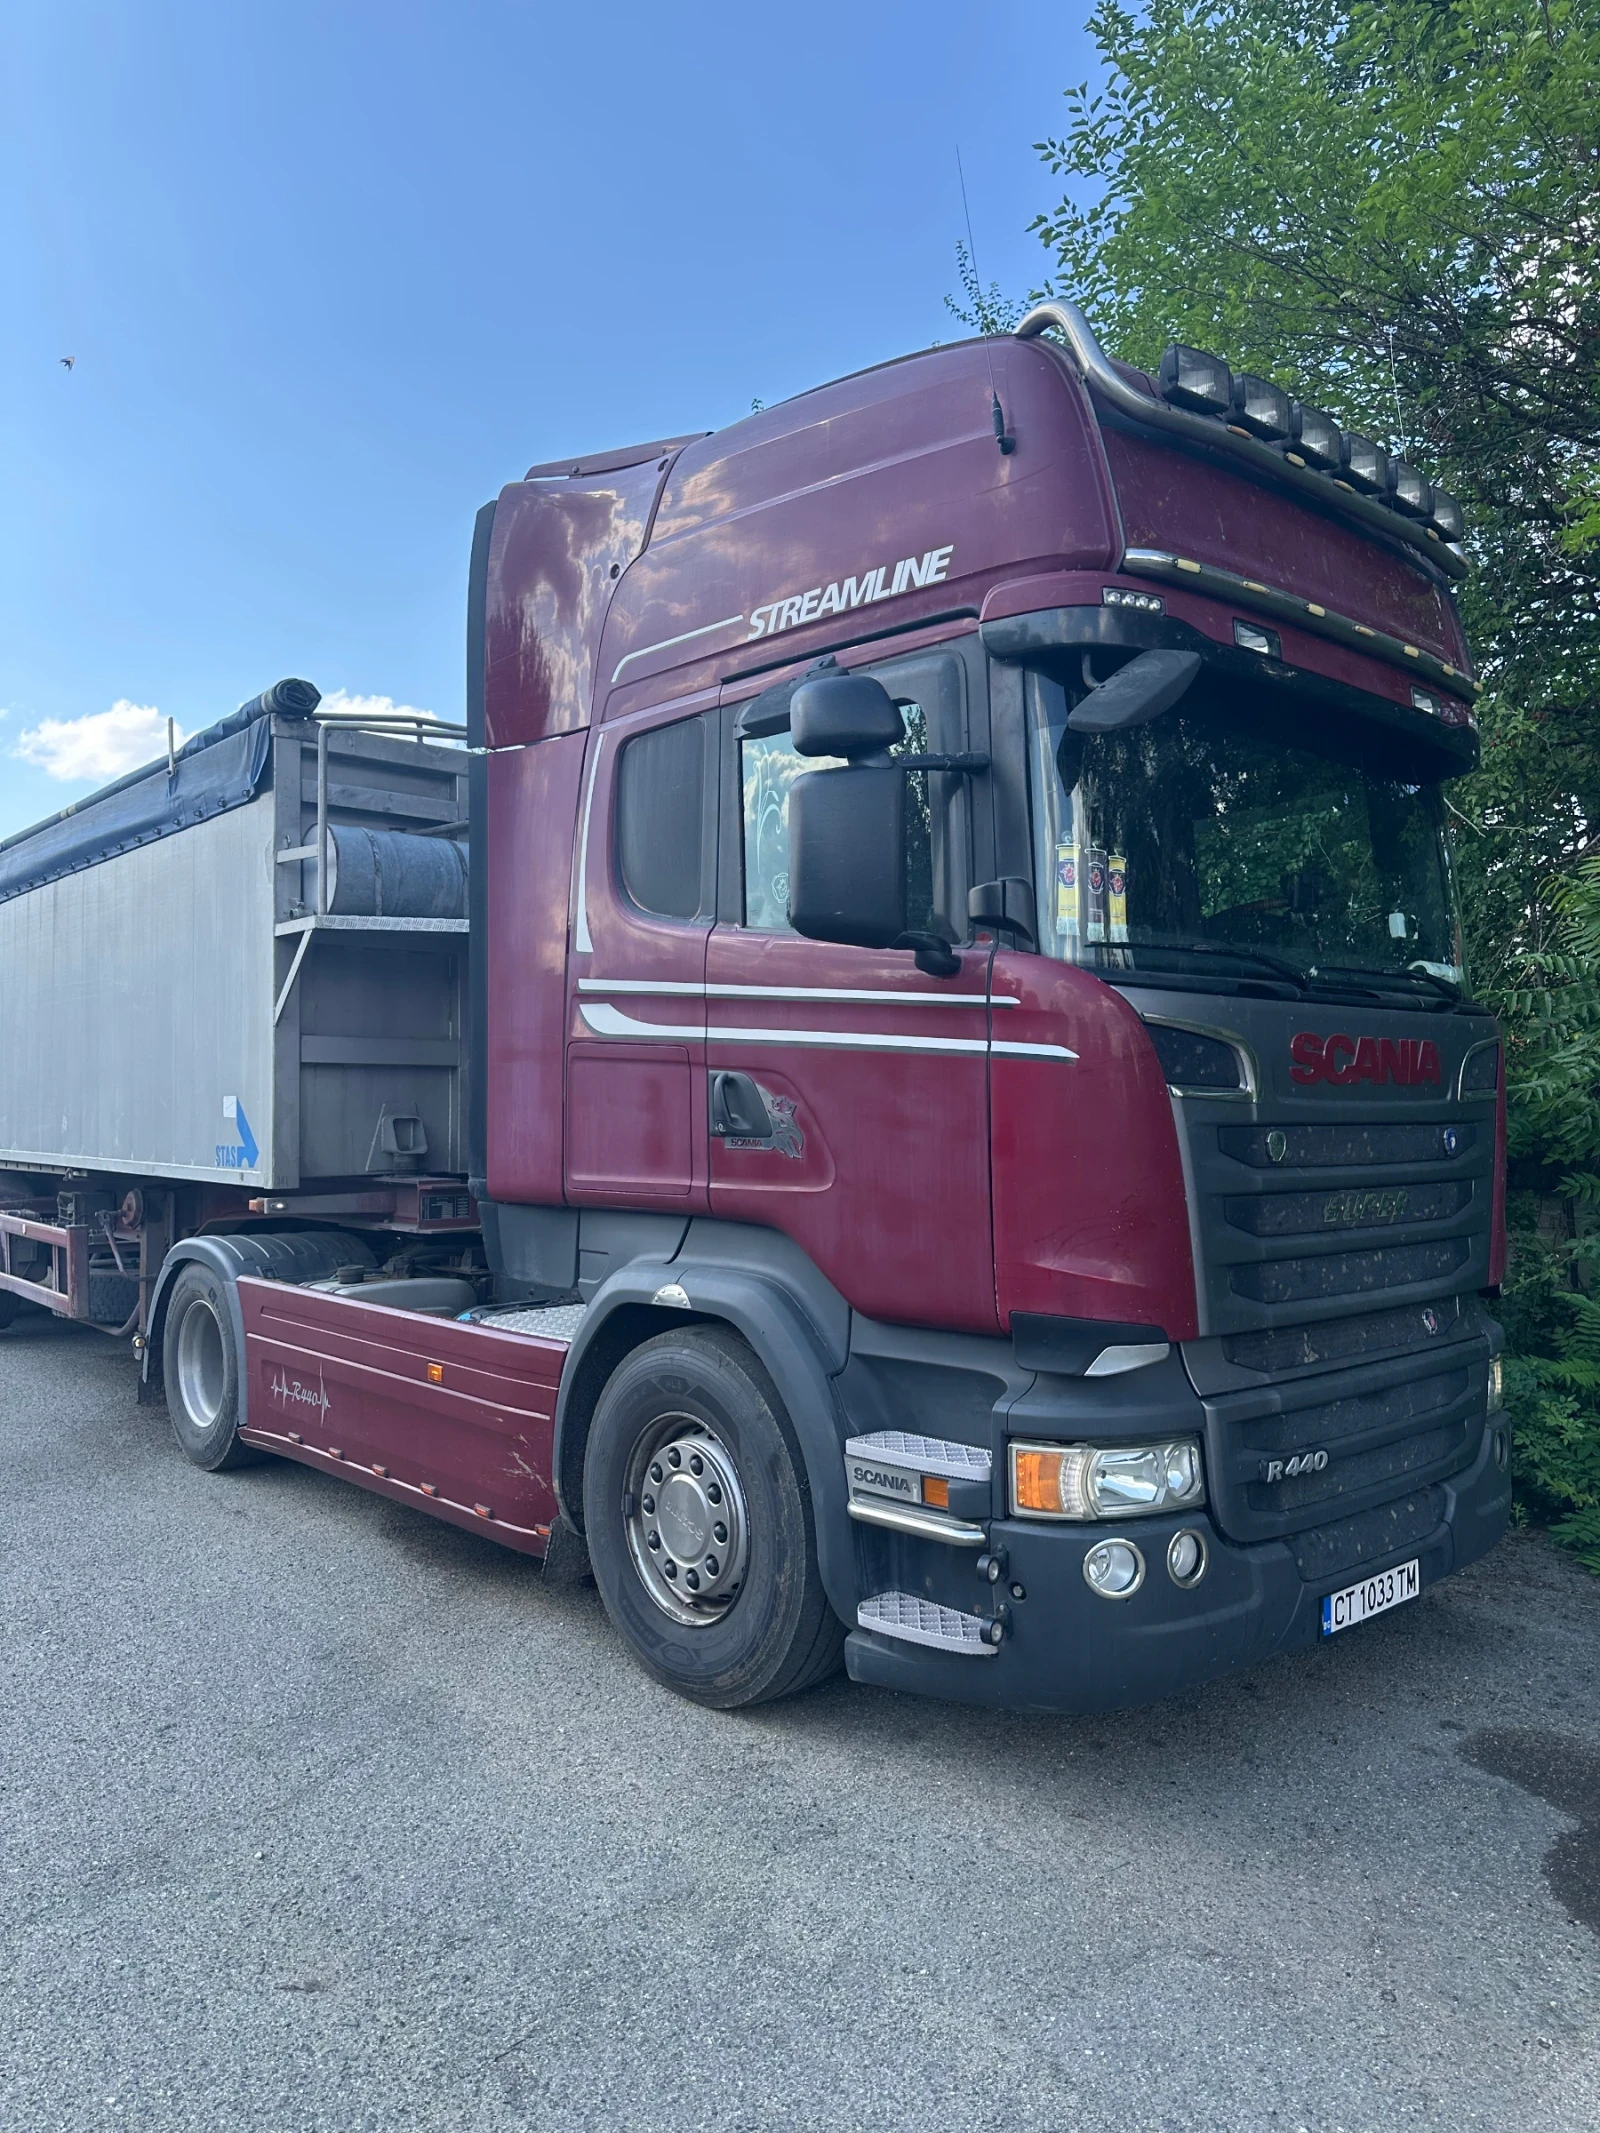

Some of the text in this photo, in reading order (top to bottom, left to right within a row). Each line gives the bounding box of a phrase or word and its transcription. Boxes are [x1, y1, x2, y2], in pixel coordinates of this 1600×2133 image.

[747, 544, 954, 641] STREAMLINE
[1289, 1032, 1440, 1085] SCANIA
[215, 1145, 236, 1168] STAS
[731, 1138, 762, 1147] SCANIA
[854, 1467, 911, 1493] SCANIA
[1334, 1563, 1416, 1625] CT 1033 TM
